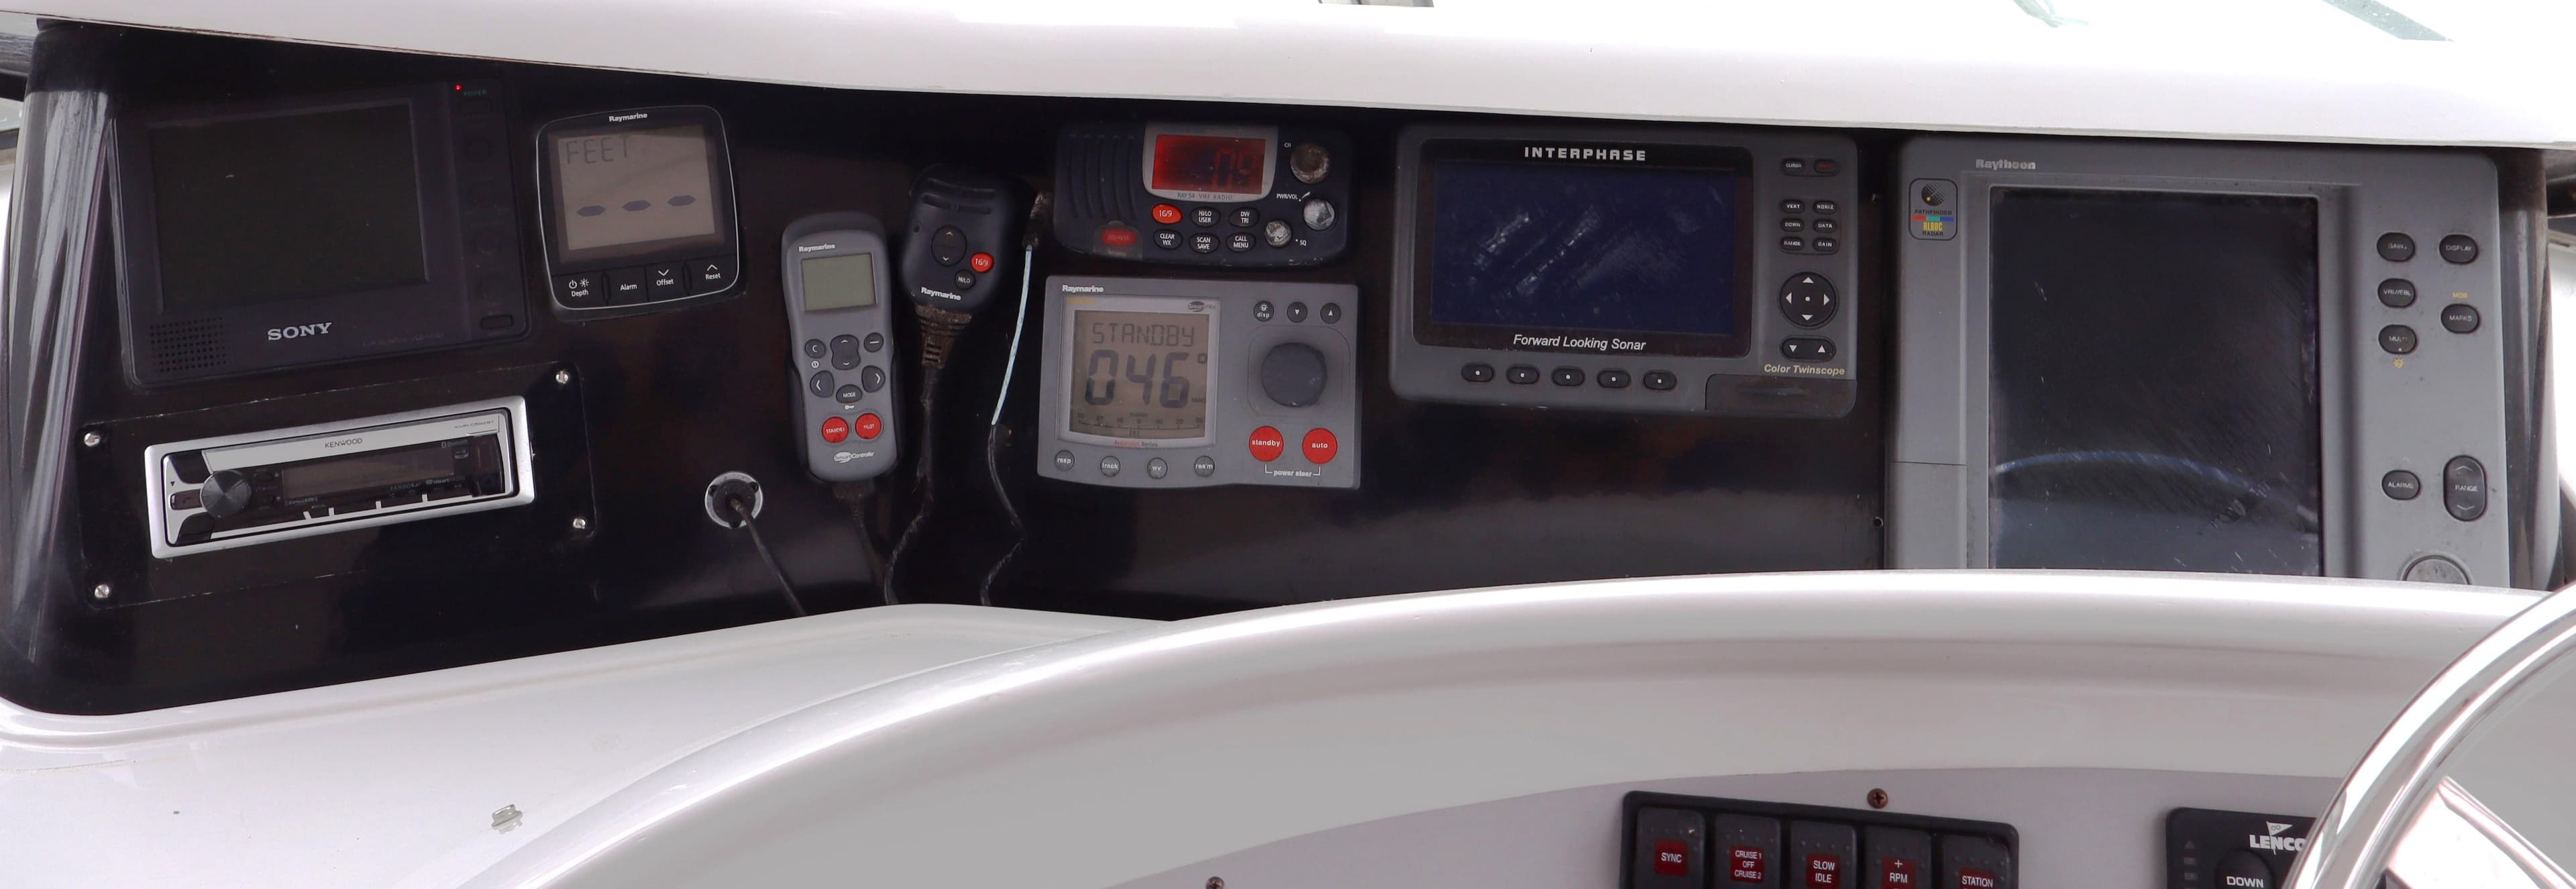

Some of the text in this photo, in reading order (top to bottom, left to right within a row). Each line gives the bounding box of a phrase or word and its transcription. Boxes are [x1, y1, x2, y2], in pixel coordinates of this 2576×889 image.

[609, 113, 647, 122] Raymarine
[565, 135, 629, 164] FEET
[1524, 146, 1646, 161] INTERPHASE
[1976, 158, 2036, 170] Raytheon
[1159, 209, 1173, 217] 16/9
[798, 244, 836, 253] Raymarine
[975, 258, 988, 266] 16/9
[571, 289, 589, 297] Depth
[921, 286, 961, 301] Raymarine
[1062, 284, 1104, 293] Raymarine
[267, 322, 332, 341] SONY
[1092, 323, 1195, 347] STANDBY
[1513, 334, 1646, 351] Forward Looking Sonar
[1764, 364, 1845, 376] Color Twinscope
[325, 437, 363, 449] KENWOOD
[1252, 439, 1281, 448] standby
[1273, 469, 1294, 477] power
[2249, 834, 2307, 851] LENCO
[1661, 851, 1682, 864] SYNC
[1735, 849, 1757, 859] CRUISE
[1742, 860, 1755, 868] OFF
[1813, 859, 1835, 871] SLOW
[1734, 869, 1757, 879] CRUISE
[1815, 872, 1832, 884] IDLE
[1889, 872, 1908, 884] RPM
[1962, 875, 1993, 888] STATION
[2226, 876, 2264, 888] DOWN
